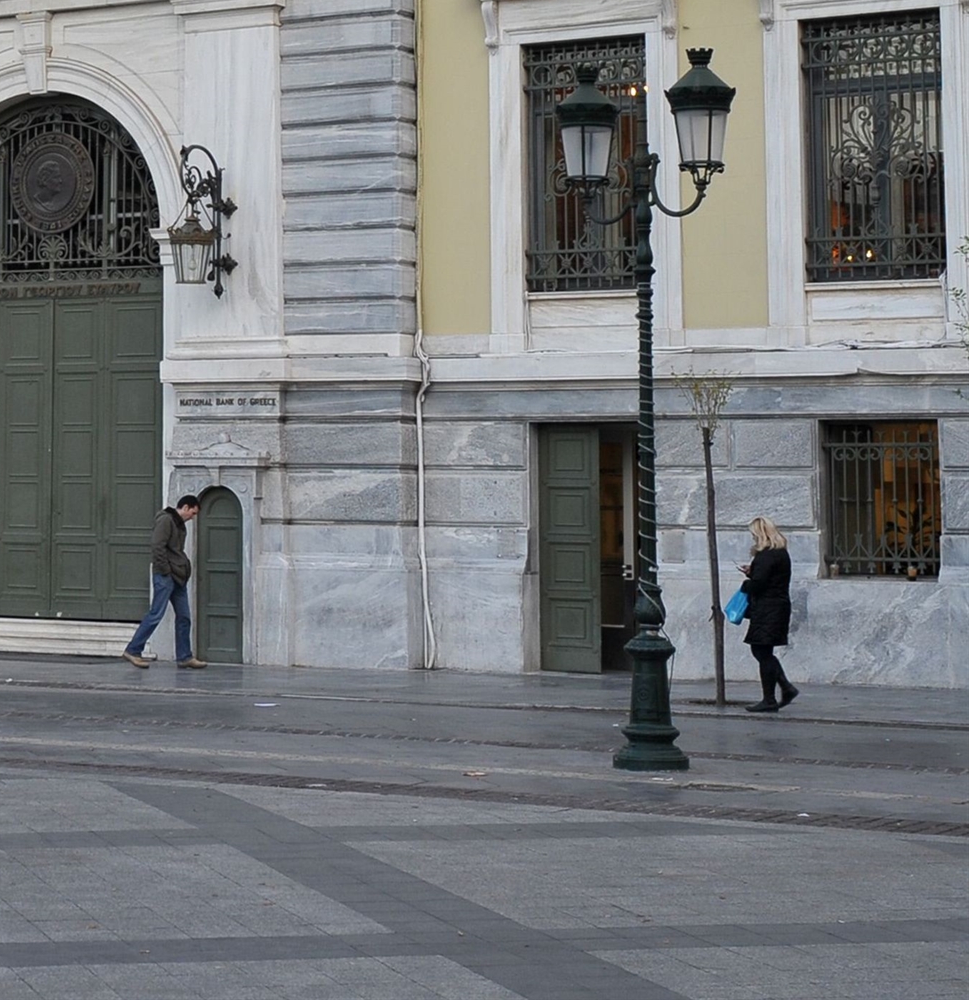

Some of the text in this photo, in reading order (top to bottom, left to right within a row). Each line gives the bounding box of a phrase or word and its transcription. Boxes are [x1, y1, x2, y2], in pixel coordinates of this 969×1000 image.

[179, 398, 277, 407] NATIONAL BANK OF GREECE
